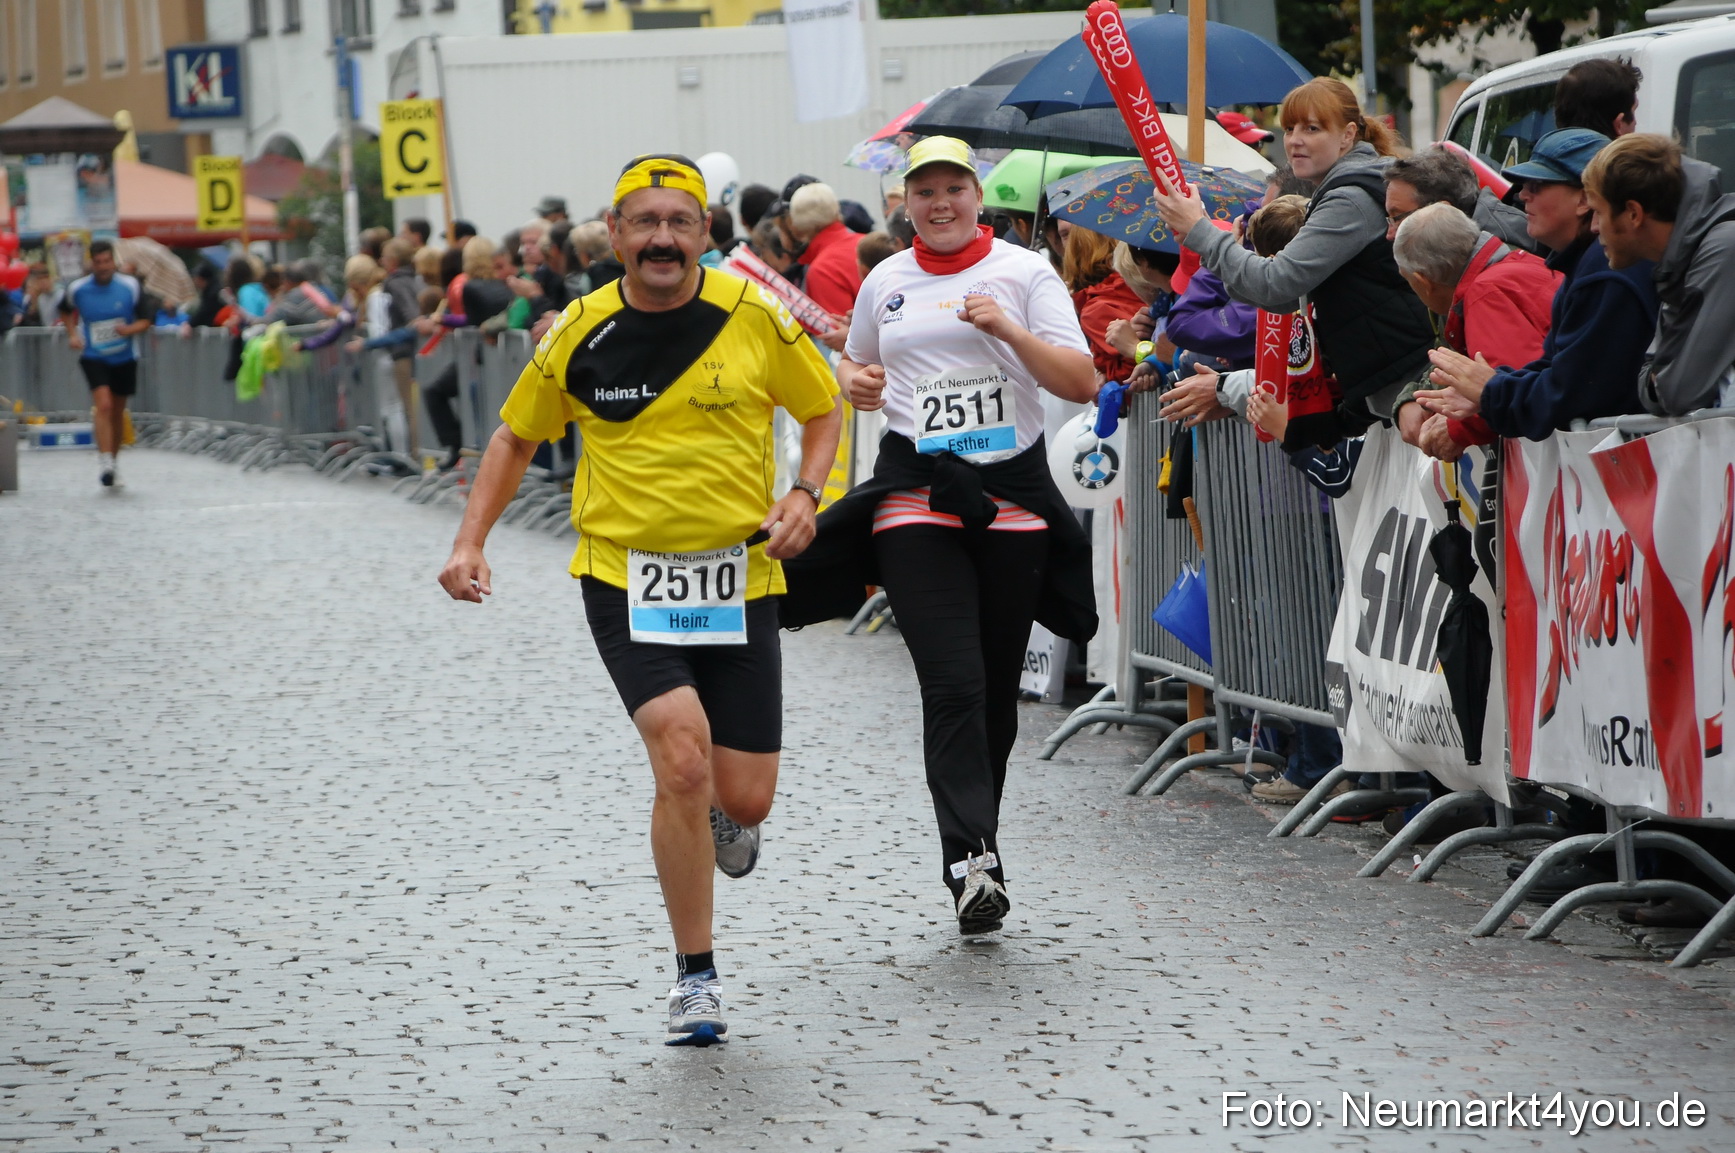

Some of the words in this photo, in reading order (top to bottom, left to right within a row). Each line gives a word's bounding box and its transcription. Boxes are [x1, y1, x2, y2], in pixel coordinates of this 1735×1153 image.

[1128, 86, 1160, 139] BKK
[398, 130, 428, 174] C
[210, 180, 233, 211] D
[588, 320, 616, 350] STANNO
[1264, 312, 1281, 359] BKK
[702, 361, 725, 370] TSV
[594, 386, 638, 401] Heinz
[642, 384, 657, 397] L.
[948, 375, 999, 388] Neumarkt
[688, 396, 738, 412] Burgthann
[922, 387, 1004, 432] 2511
[948, 437, 990, 453] Esther
[673, 551, 727, 562] Neumarkt
[641, 561, 735, 602] 2510
[669, 613, 710, 628] Heinz
